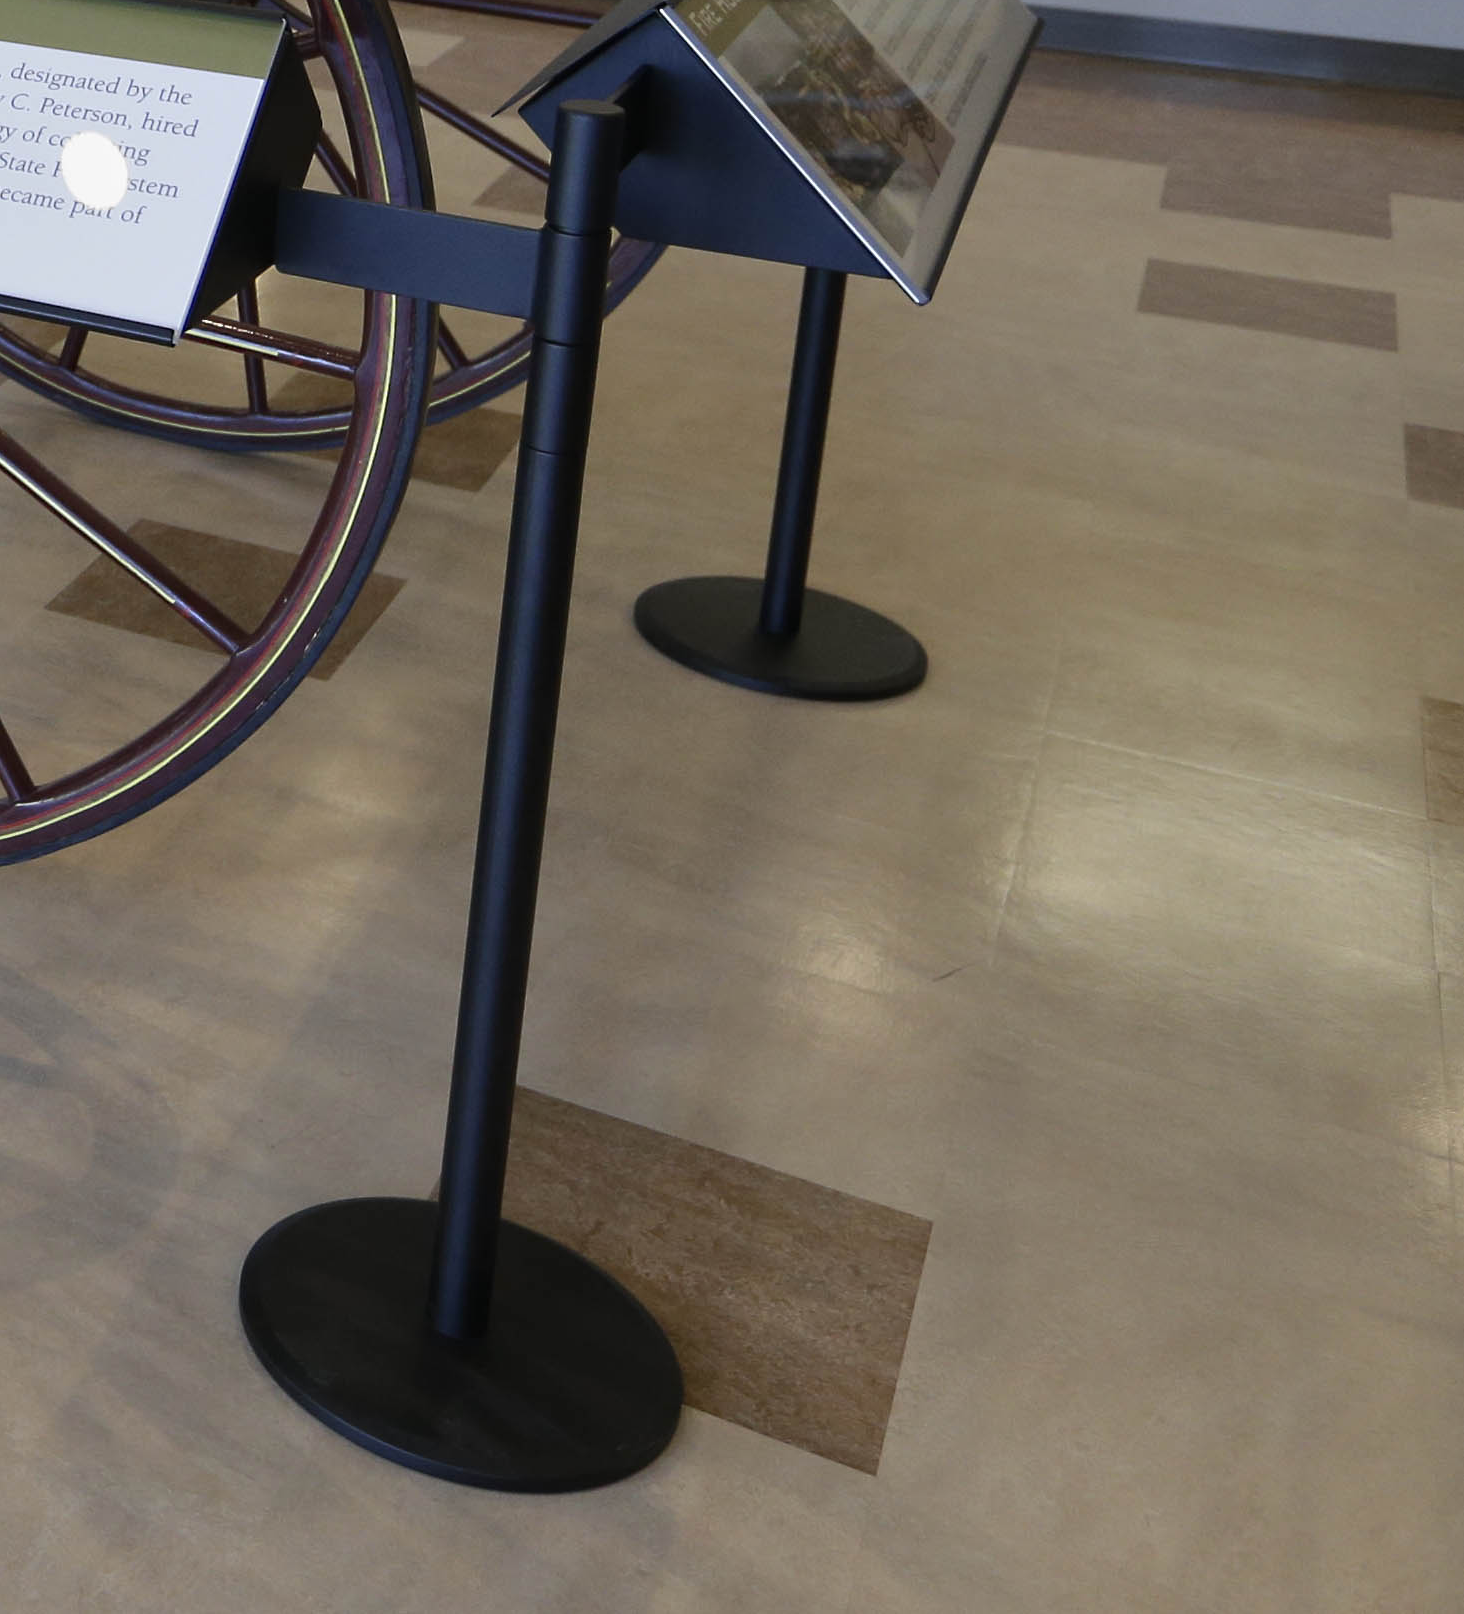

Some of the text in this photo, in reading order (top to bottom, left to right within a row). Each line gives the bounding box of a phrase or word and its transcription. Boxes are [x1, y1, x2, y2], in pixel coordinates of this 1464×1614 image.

[10, 62, 122, 95] designated
[126, 78, 154, 104] by
[158, 84, 193, 106] the
[10, 92, 30, 112] C.
[38, 97, 133, 130] Peterson,
[140, 111, 200, 138] hired
[21, 125, 48, 144] of
[120, 206, 148, 225] of
